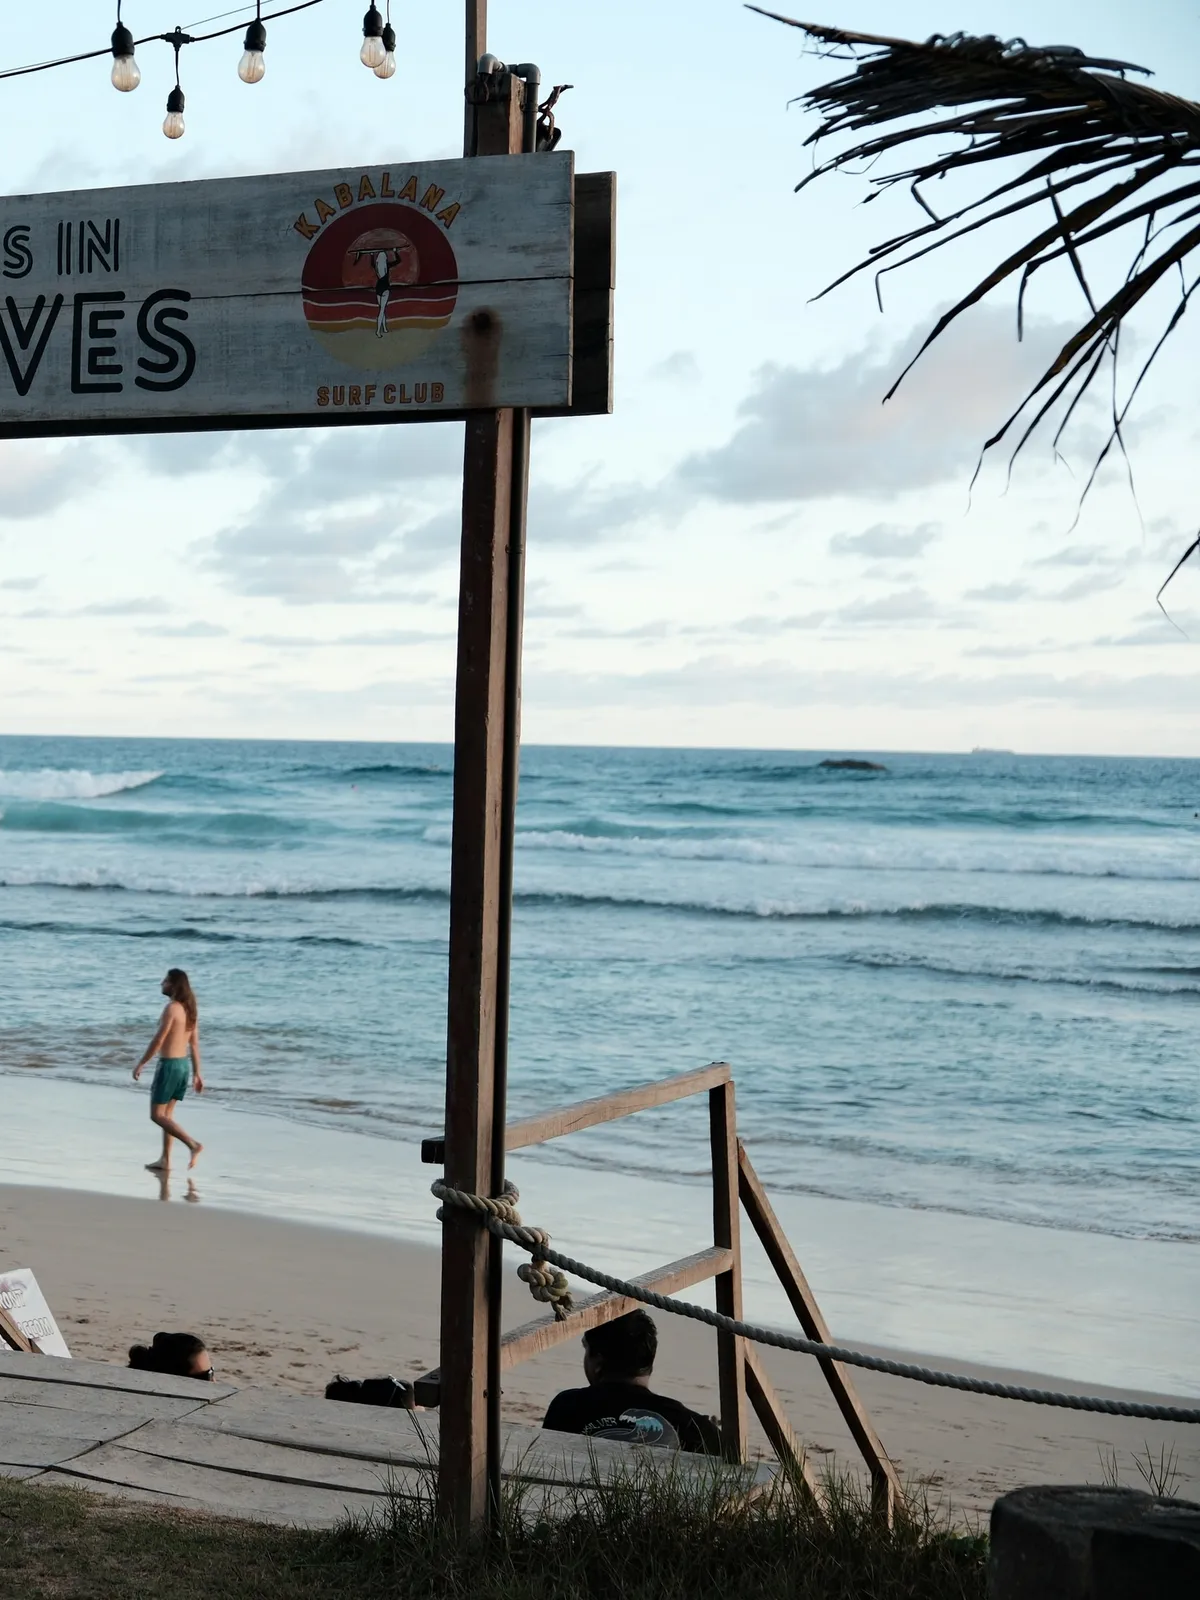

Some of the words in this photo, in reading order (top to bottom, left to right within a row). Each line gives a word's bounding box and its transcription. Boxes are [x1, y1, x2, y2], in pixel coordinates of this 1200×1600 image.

[293, 172, 462, 240] KABALANA
[57, 218, 121, 276] IN
[316, 384, 377, 406] SURF
[383, 382, 445, 404] CLUB
